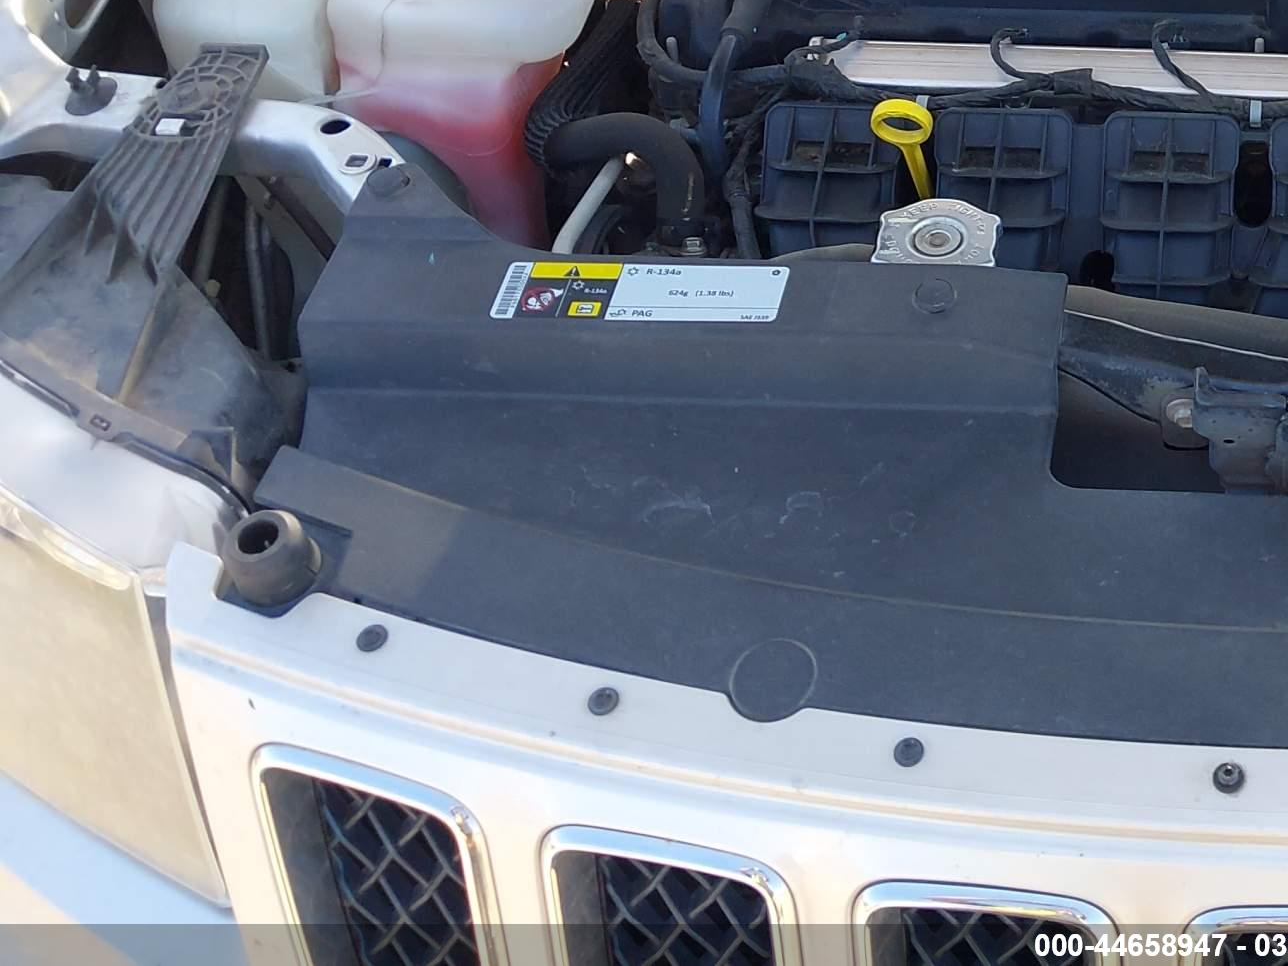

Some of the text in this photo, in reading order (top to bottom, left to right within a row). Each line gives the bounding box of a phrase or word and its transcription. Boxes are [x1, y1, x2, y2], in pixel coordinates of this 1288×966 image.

[646, 267, 682, 276] R-134a
[668, 289, 689, 297] 624g
[631, 309, 654, 318] PAG
